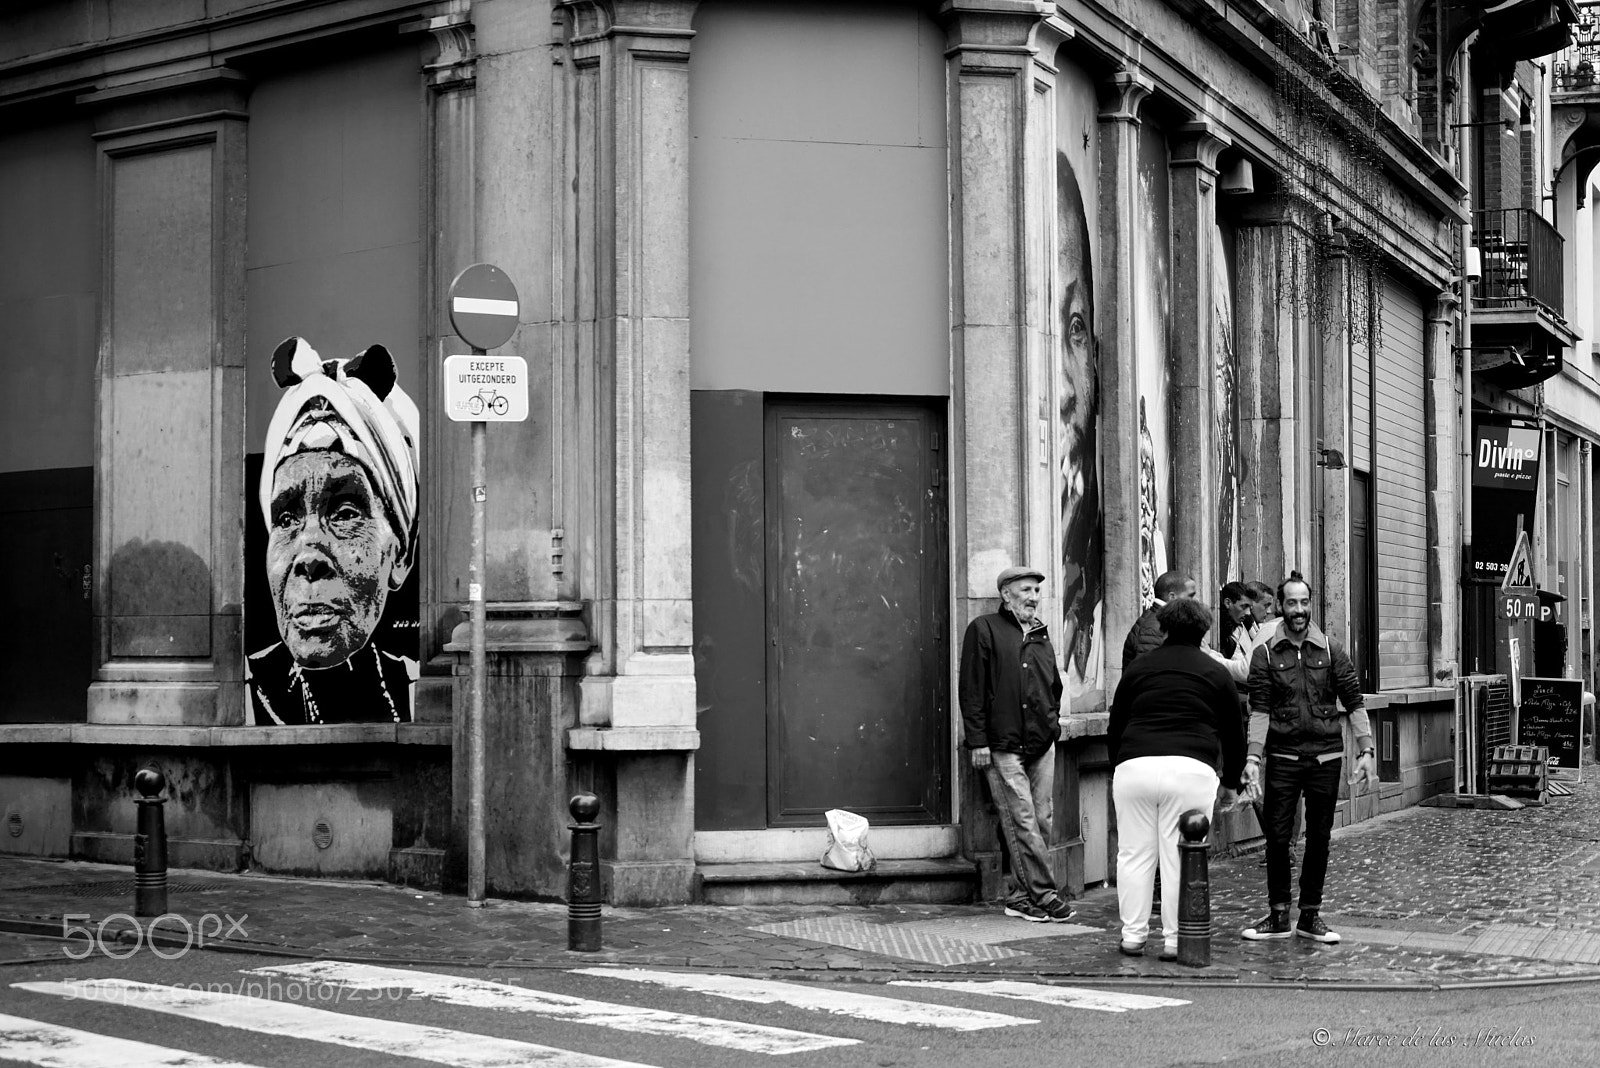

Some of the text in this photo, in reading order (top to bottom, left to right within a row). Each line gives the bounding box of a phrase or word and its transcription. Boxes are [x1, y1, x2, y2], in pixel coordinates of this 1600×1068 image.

[470, 362, 504, 371] EXCEPTE
[459, 374, 516, 384] UITGEZONDERD
[1475, 561, 1483, 570] 02
[1486, 562, 1498, 571] 503
[1506, 598, 1535, 617] 50 m
[1540, 606, 1551, 622] P
